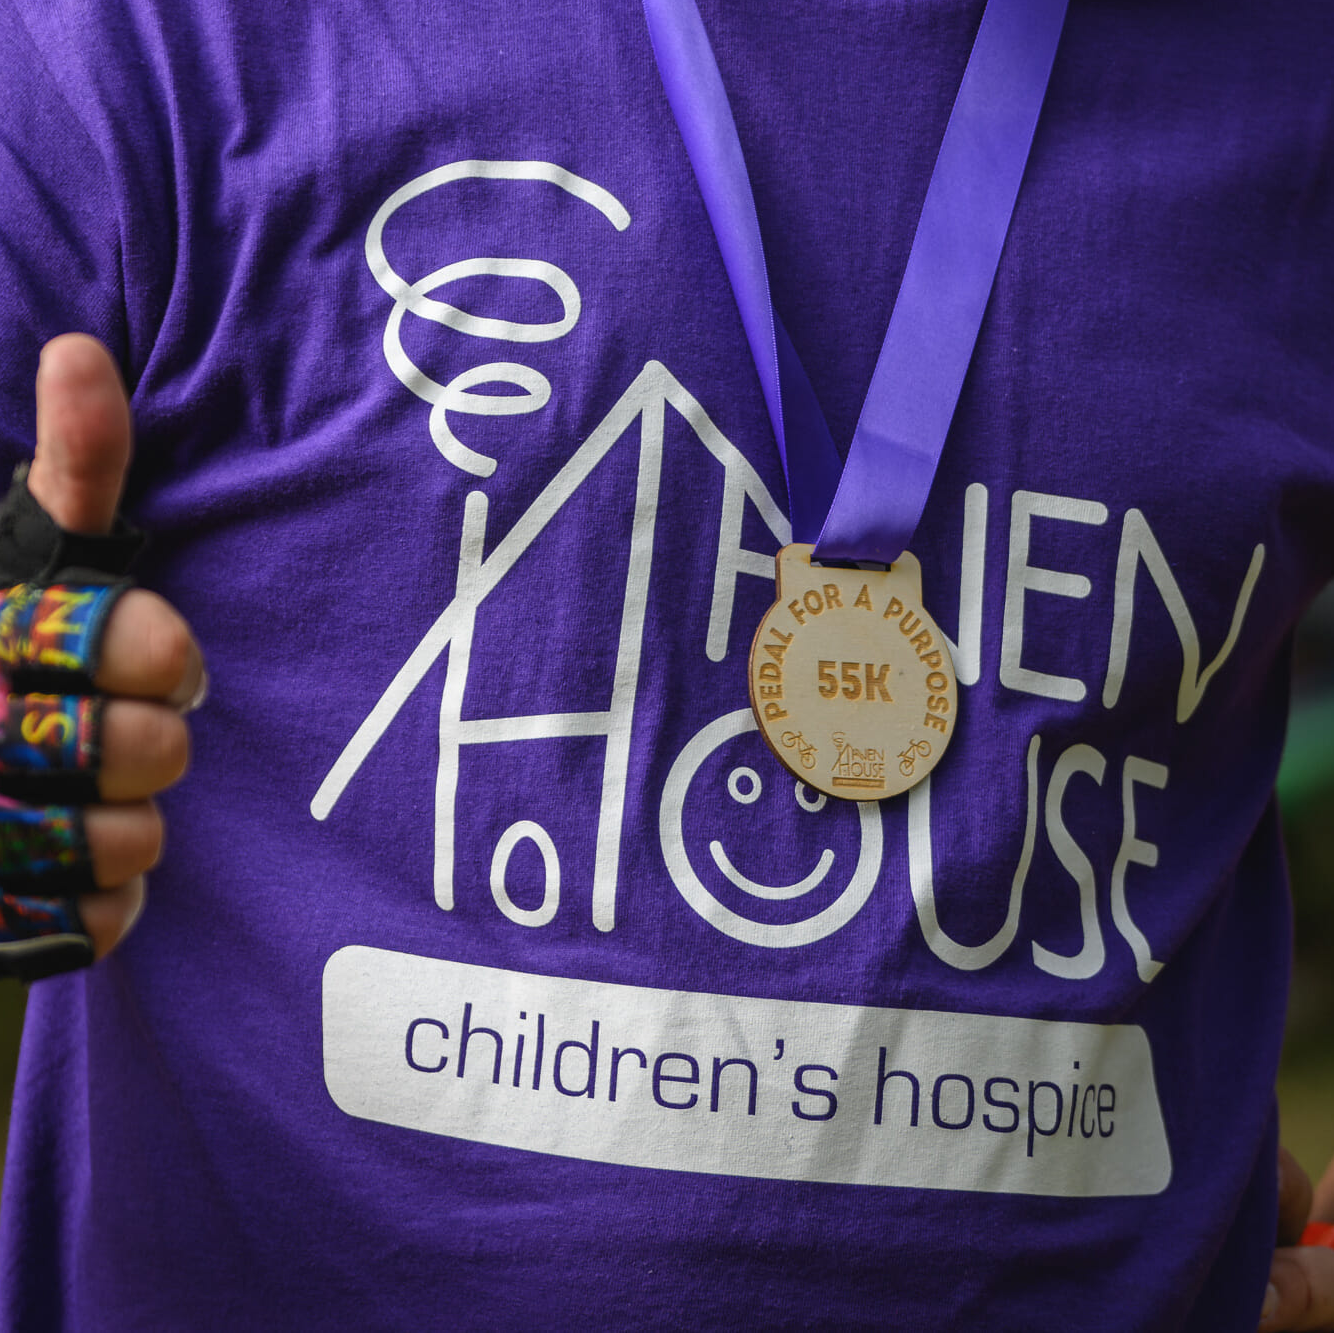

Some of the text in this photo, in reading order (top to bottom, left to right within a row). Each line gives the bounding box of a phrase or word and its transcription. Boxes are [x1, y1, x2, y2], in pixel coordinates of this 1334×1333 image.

[758, 583, 949, 735] PEDAL FOR A PURPOSE
[818, 660, 893, 703] 55K
[404, 1002, 1117, 1158] children's hospice
